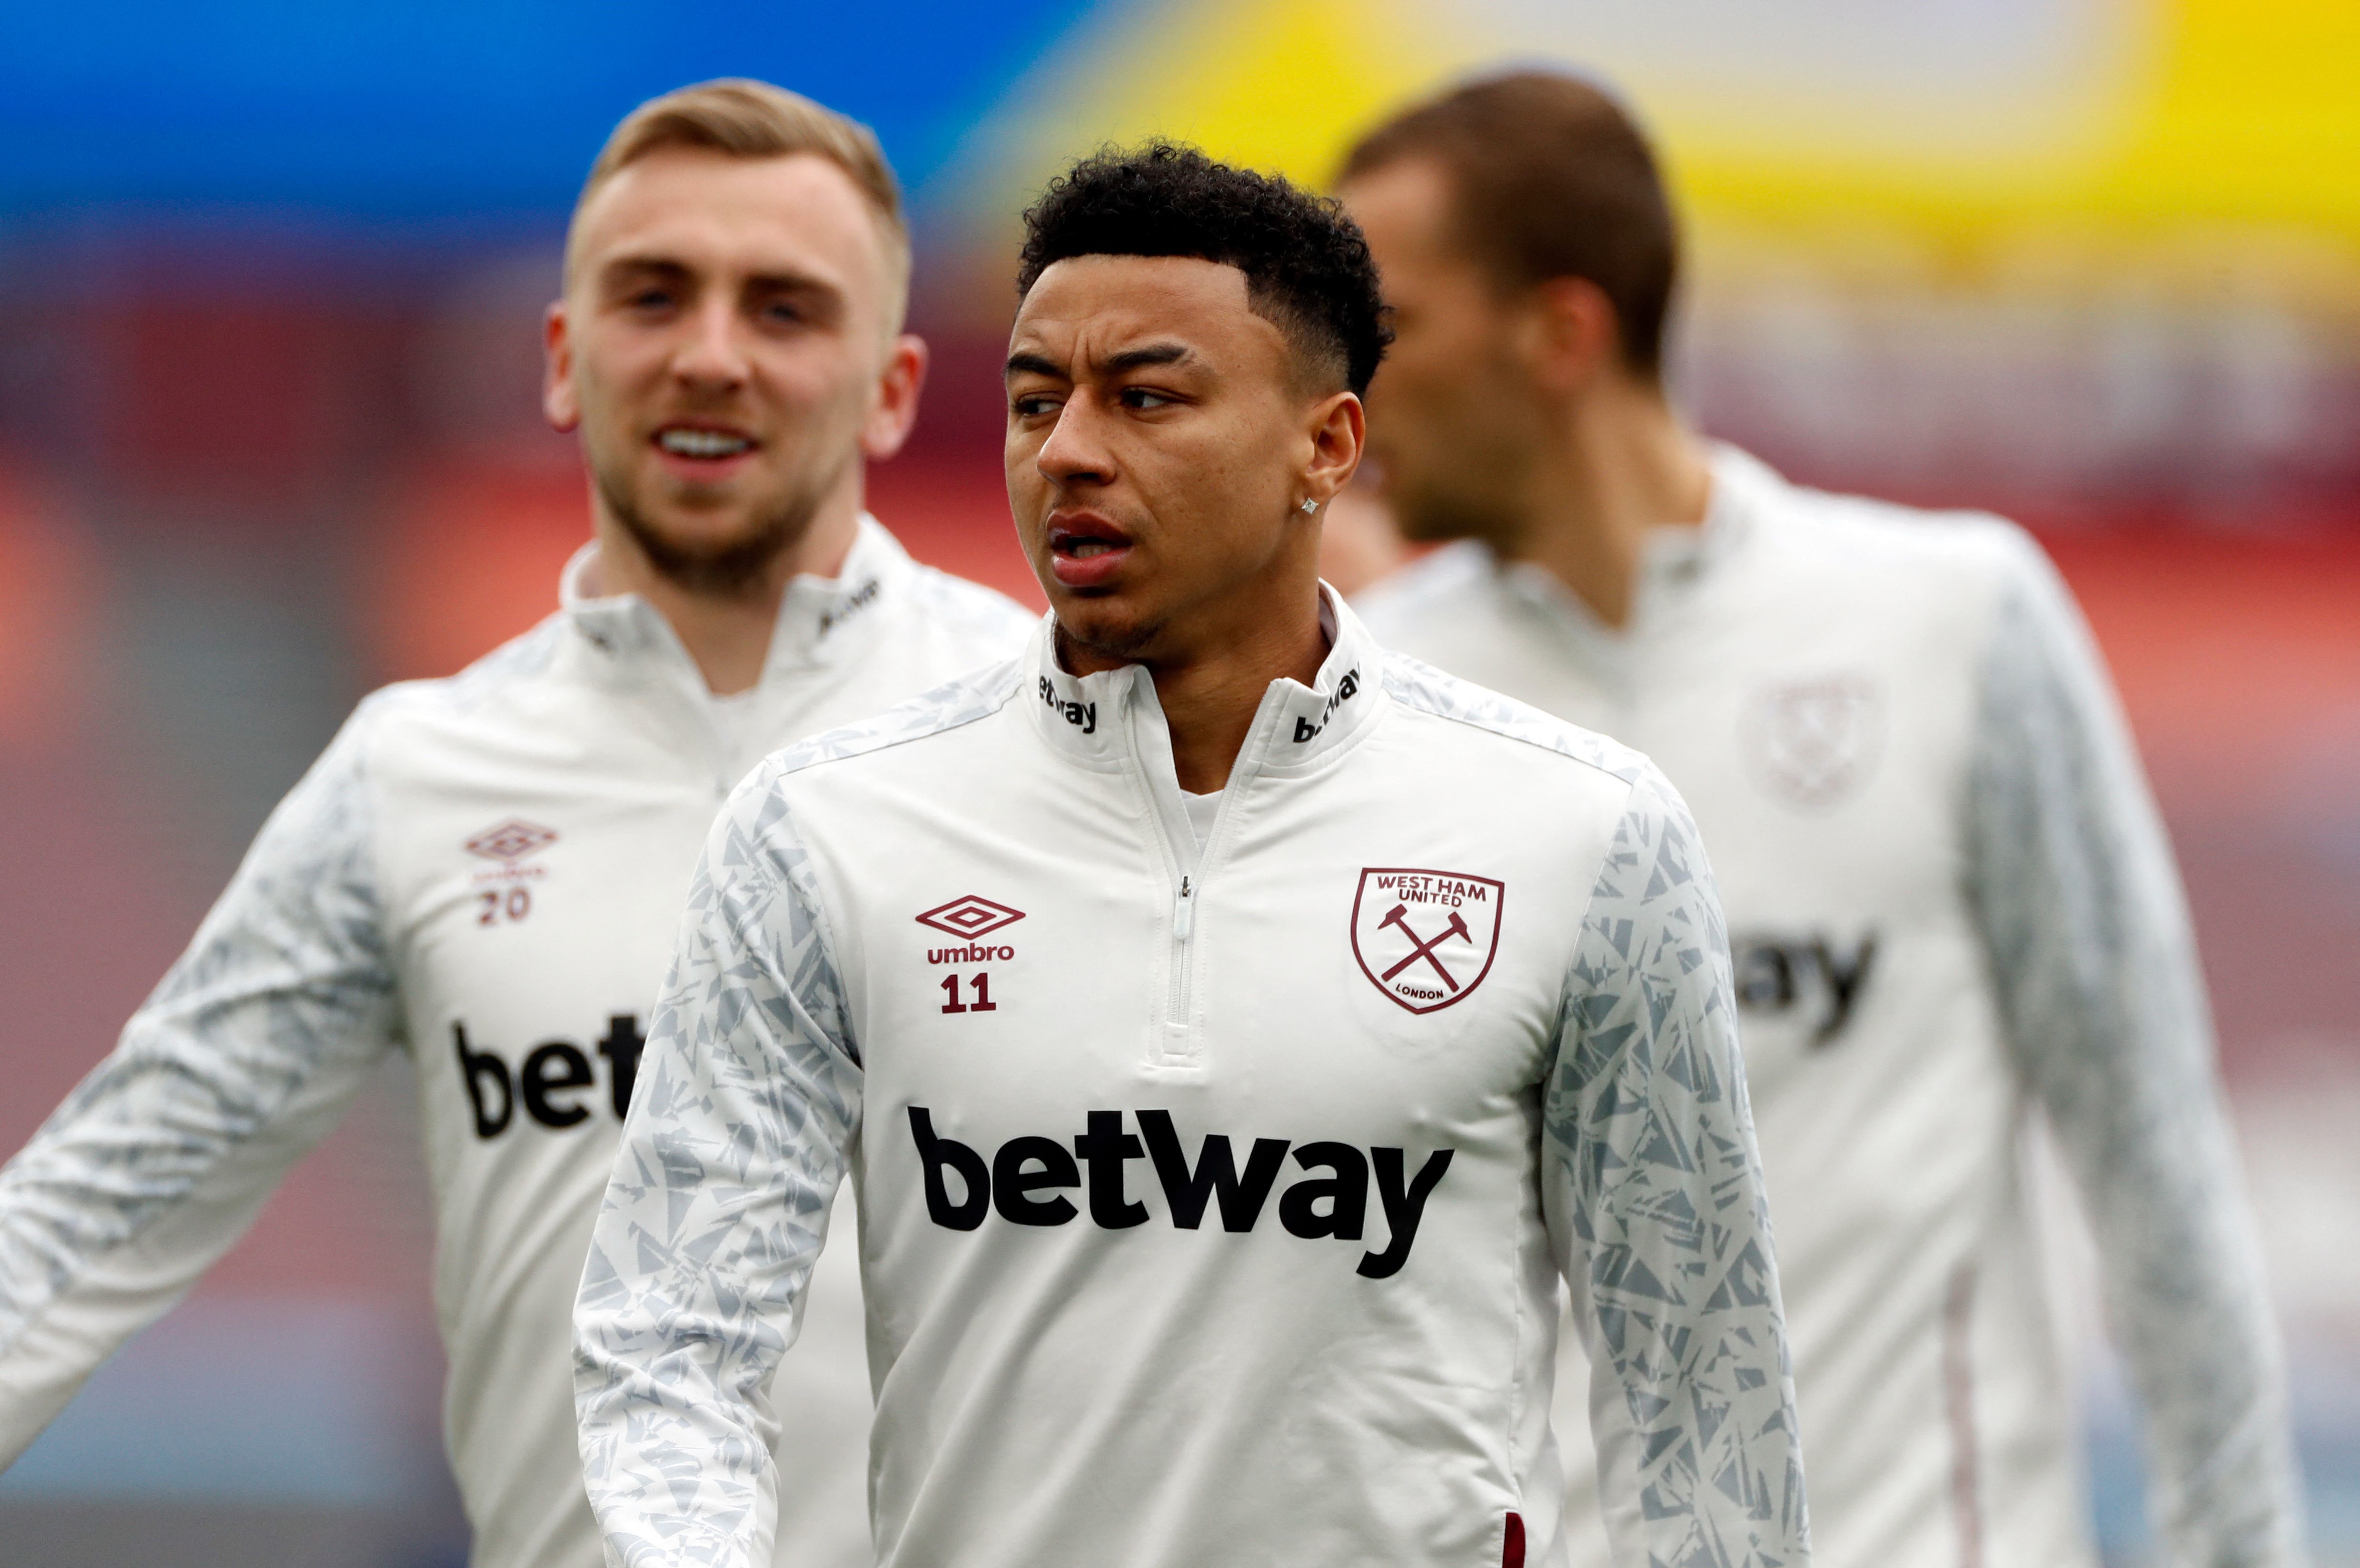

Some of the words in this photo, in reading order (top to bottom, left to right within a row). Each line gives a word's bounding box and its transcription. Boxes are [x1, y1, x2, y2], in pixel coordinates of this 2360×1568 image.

[1378, 876, 1433, 890] WEST
[1438, 879, 1486, 901] HAM
[1399, 889, 1462, 907] UNITED
[476, 886, 531, 927] 20
[927, 943, 1014, 965] umbro
[941, 973, 996, 1014] 11
[1395, 983, 1444, 999] LONDON
[907, 1106, 1455, 1279] betway
